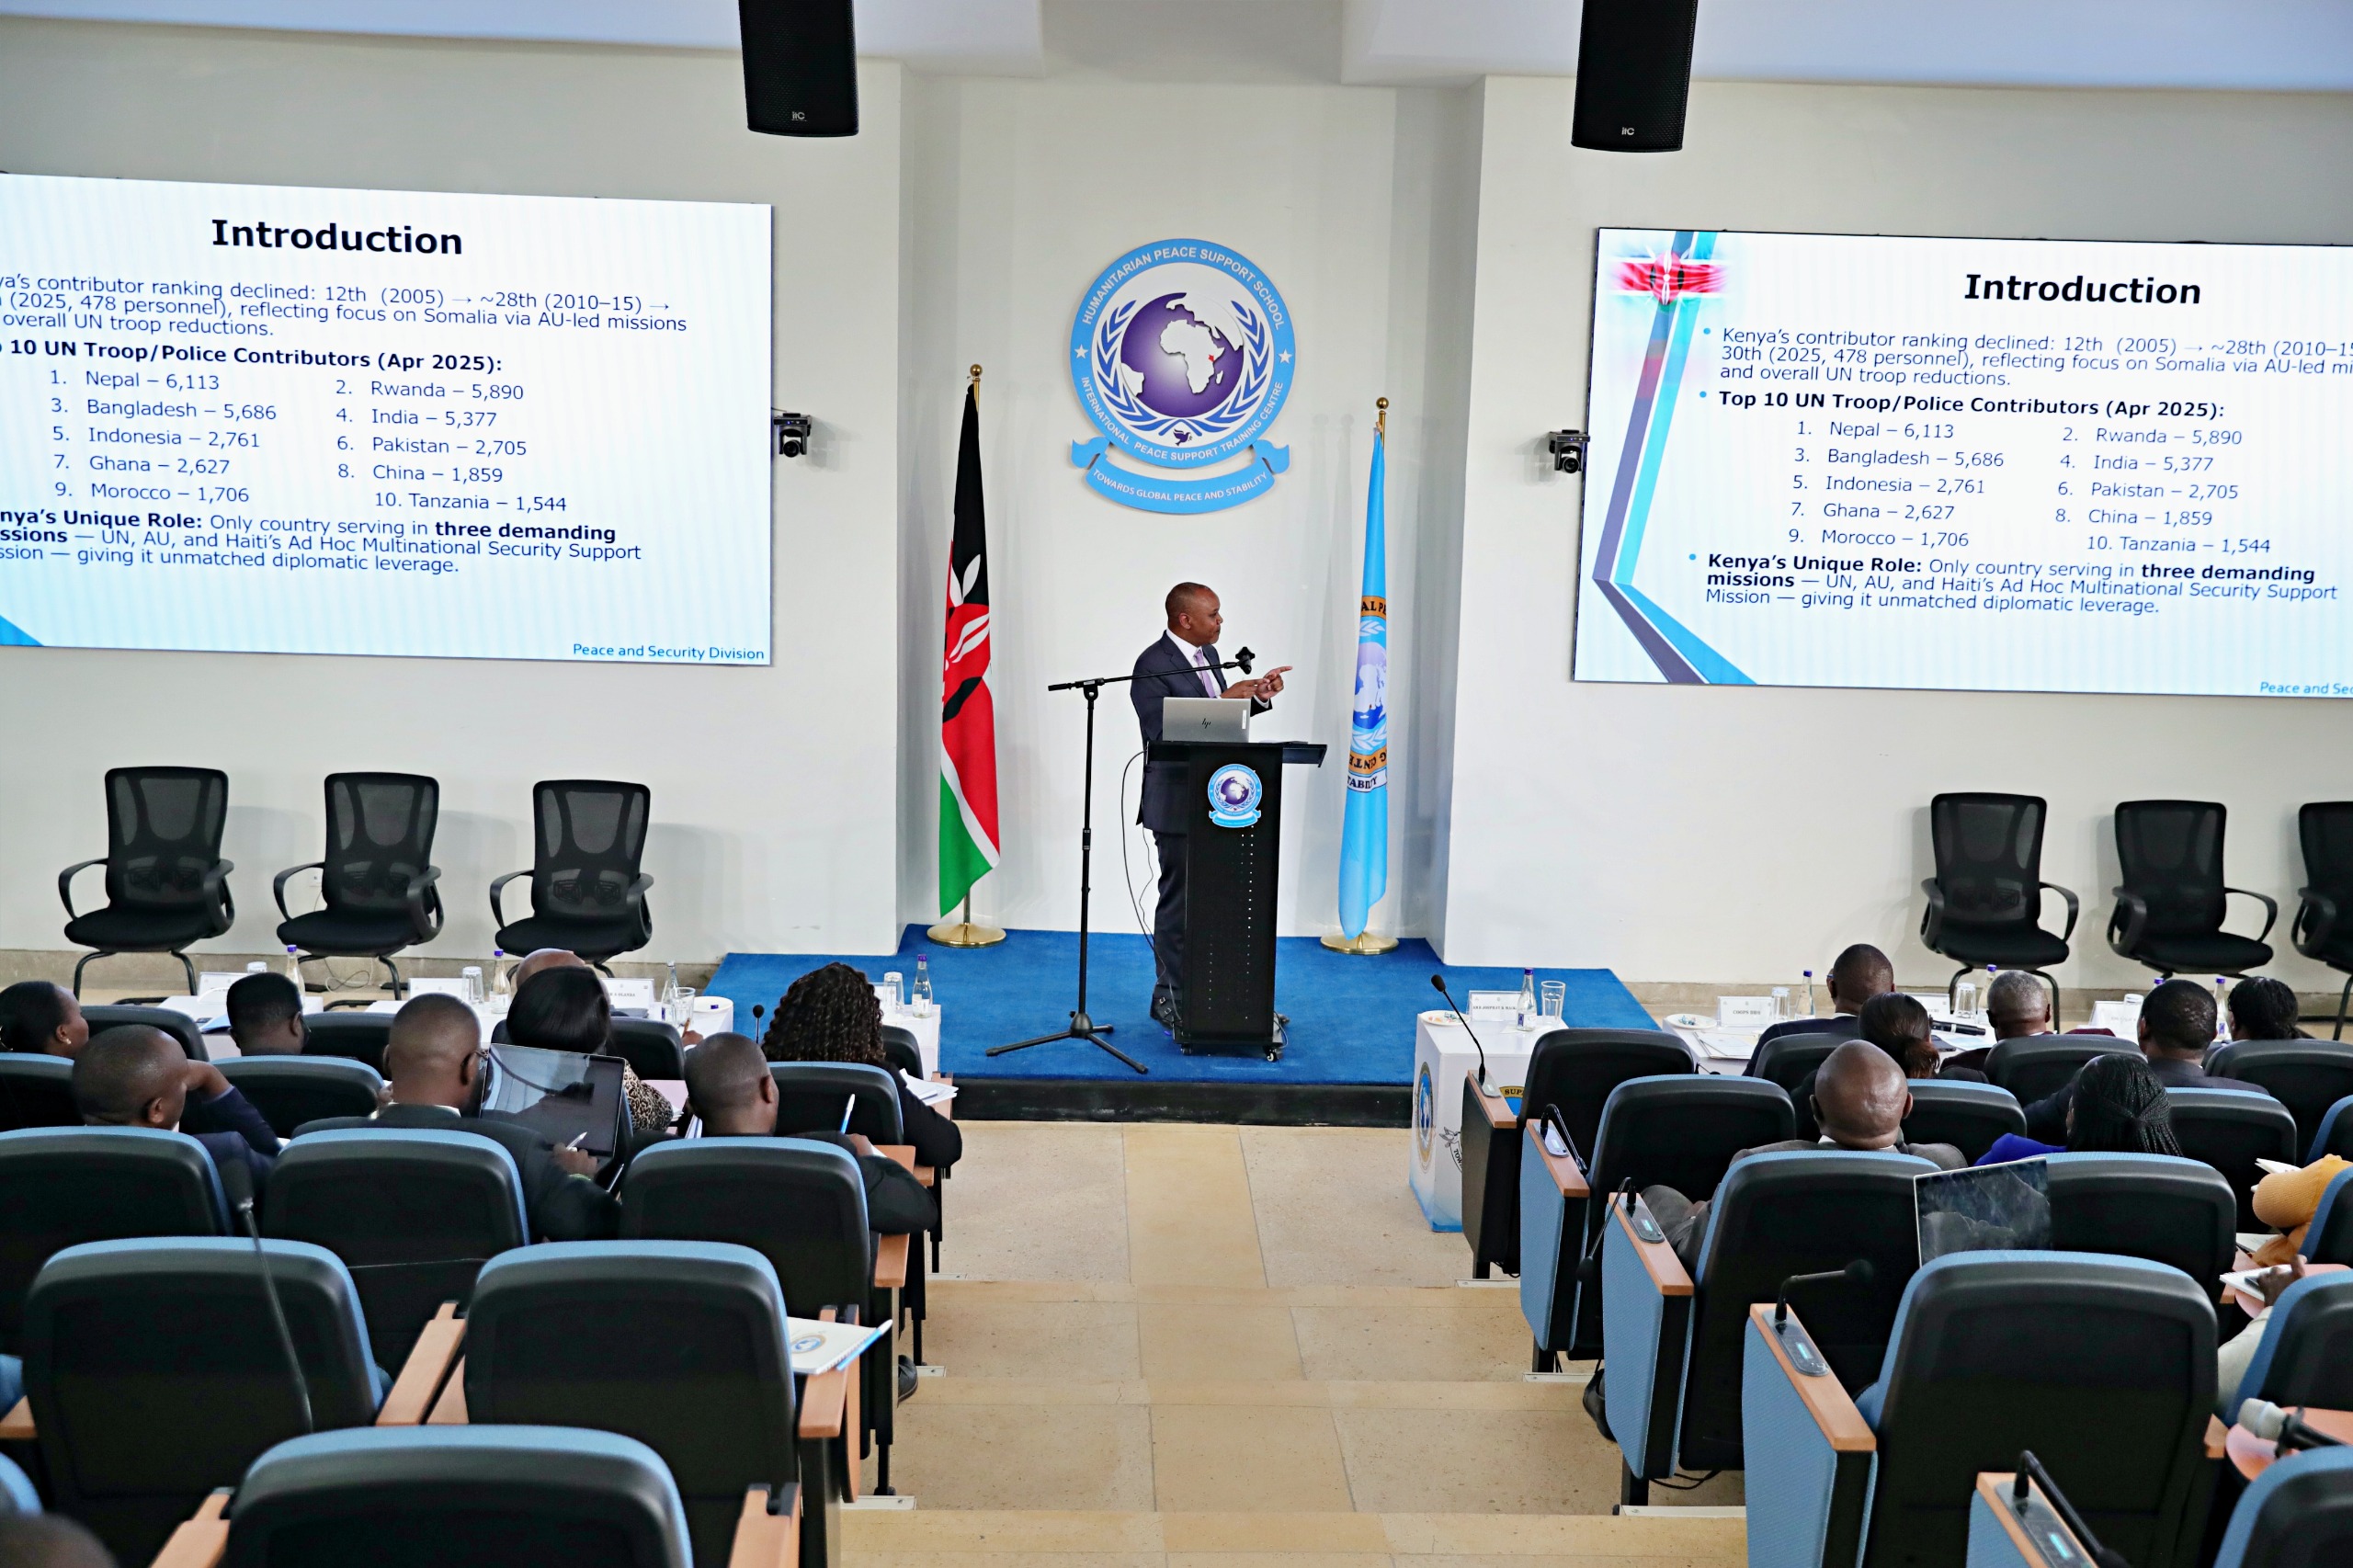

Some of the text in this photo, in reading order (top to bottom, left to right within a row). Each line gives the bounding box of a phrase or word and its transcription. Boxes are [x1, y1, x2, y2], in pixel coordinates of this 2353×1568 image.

[211, 219, 462, 256] Introduction
[37, 276, 145, 294] contributor
[152, 279, 223, 300] ranking
[230, 281, 315, 301] declined:
[325, 286, 367, 302] 12th
[381, 287, 444, 309] (2005)
[480, 291, 537, 308] ~28th
[1082, 247, 1286, 330] HUMANITARIAN PEACE SUPPORT SCHOOL
[1963, 273, 2201, 305] Introduction
[9, 290, 688, 332] (2025, 478 personnel), reflecting focus Somalia AU-led missions
[2, 312, 274, 336] overall troop reductions.
[1796, 330, 1896, 347] contributor
[1902, 333, 1968, 351] ranking
[1974, 334, 2055, 351] declined:
[2063, 336, 2103, 352] 12th
[2116, 337, 2177, 358] (2005)
[2211, 339, 2266, 356] ~28th
[44, 340, 502, 375] UN Troop/Police Contributors (Apr 2025):
[1722, 345, 1762, 361] 30th
[1768, 346, 1826, 366] (2025,
[1833, 348, 1867, 364] 478
[1873, 350, 1974, 369] personnel),
[1982, 352, 2065, 372] reflecting
[2072, 354, 2120, 370] focus
[2154, 356, 2225, 372] Somalia
[2264, 358, 2325, 375] AU-led
[85, 369, 220, 392] Nepal 6,113
[1759, 365, 2011, 387] overall troop reductions.
[370, 380, 524, 403] Rwanda 5,890
[86, 398, 277, 423] Bangladesh 5,686
[1718, 390, 2224, 421] Top UN Troop/Police Contributors (Apr 2025):
[371, 408, 497, 429] India 5,377
[1081, 376, 1283, 461] INTERNATIONAL PEACE SUPPORT TRAINING CENTRE
[88, 426, 260, 450] Indonesia 2,761
[1829, 421, 1954, 441] Nepal 6,113
[2096, 427, 2243, 448] Rwanda 5,890
[372, 436, 527, 459] Pakistan 2,705
[1827, 448, 2005, 470] Bangladesh 5,686
[89, 455, 231, 477] Ghana 2,627
[372, 464, 504, 485] China 1,859
[2093, 454, 2214, 474] India 5,377
[91, 483, 250, 505] Morocco 1,706
[1093, 469, 1267, 501] TOWARDS GLOBAL PEACE AND STABILITY
[1825, 475, 1984, 496] Indonesia 2,761
[2091, 482, 2239, 502] Pakistan 2,705
[407, 493, 567, 515] Tanzania 1,544
[1823, 502, 1955, 522] Ghana 2,627
[63, 509, 616, 545] Unique Role: country serving three demanding
[2088, 508, 2212, 528] China 1,859
[362, 537, 481, 555] Multinational
[488, 540, 563, 561] Security
[568, 542, 642, 562] Support
[1822, 528, 1970, 550] Morocco 1,706
[2119, 536, 2271, 556] Tanzania 1,544
[77, 546, 460, 575] giving unmatched diplomatic leverage.
[1792, 555, 1865, 574] Unique
[1870, 557, 1922, 574] Role:
[1975, 561, 2043, 581] country
[2048, 564, 2112, 581] serving
[2141, 562, 2196, 579] three
[2200, 564, 2315, 585] demanding
[1707, 571, 1795, 588] missions
[2070, 579, 2183, 597] Multinational
[2188, 582, 2261, 601] Security
[2267, 584, 2338, 603] Support
[1706, 588, 2159, 617] Mission giving unmatched diplomatic leverage.
[573, 642, 765, 662] Peace and Security Division
[2260, 681, 2301, 694] Peace
[2303, 683, 2330, 694] and
